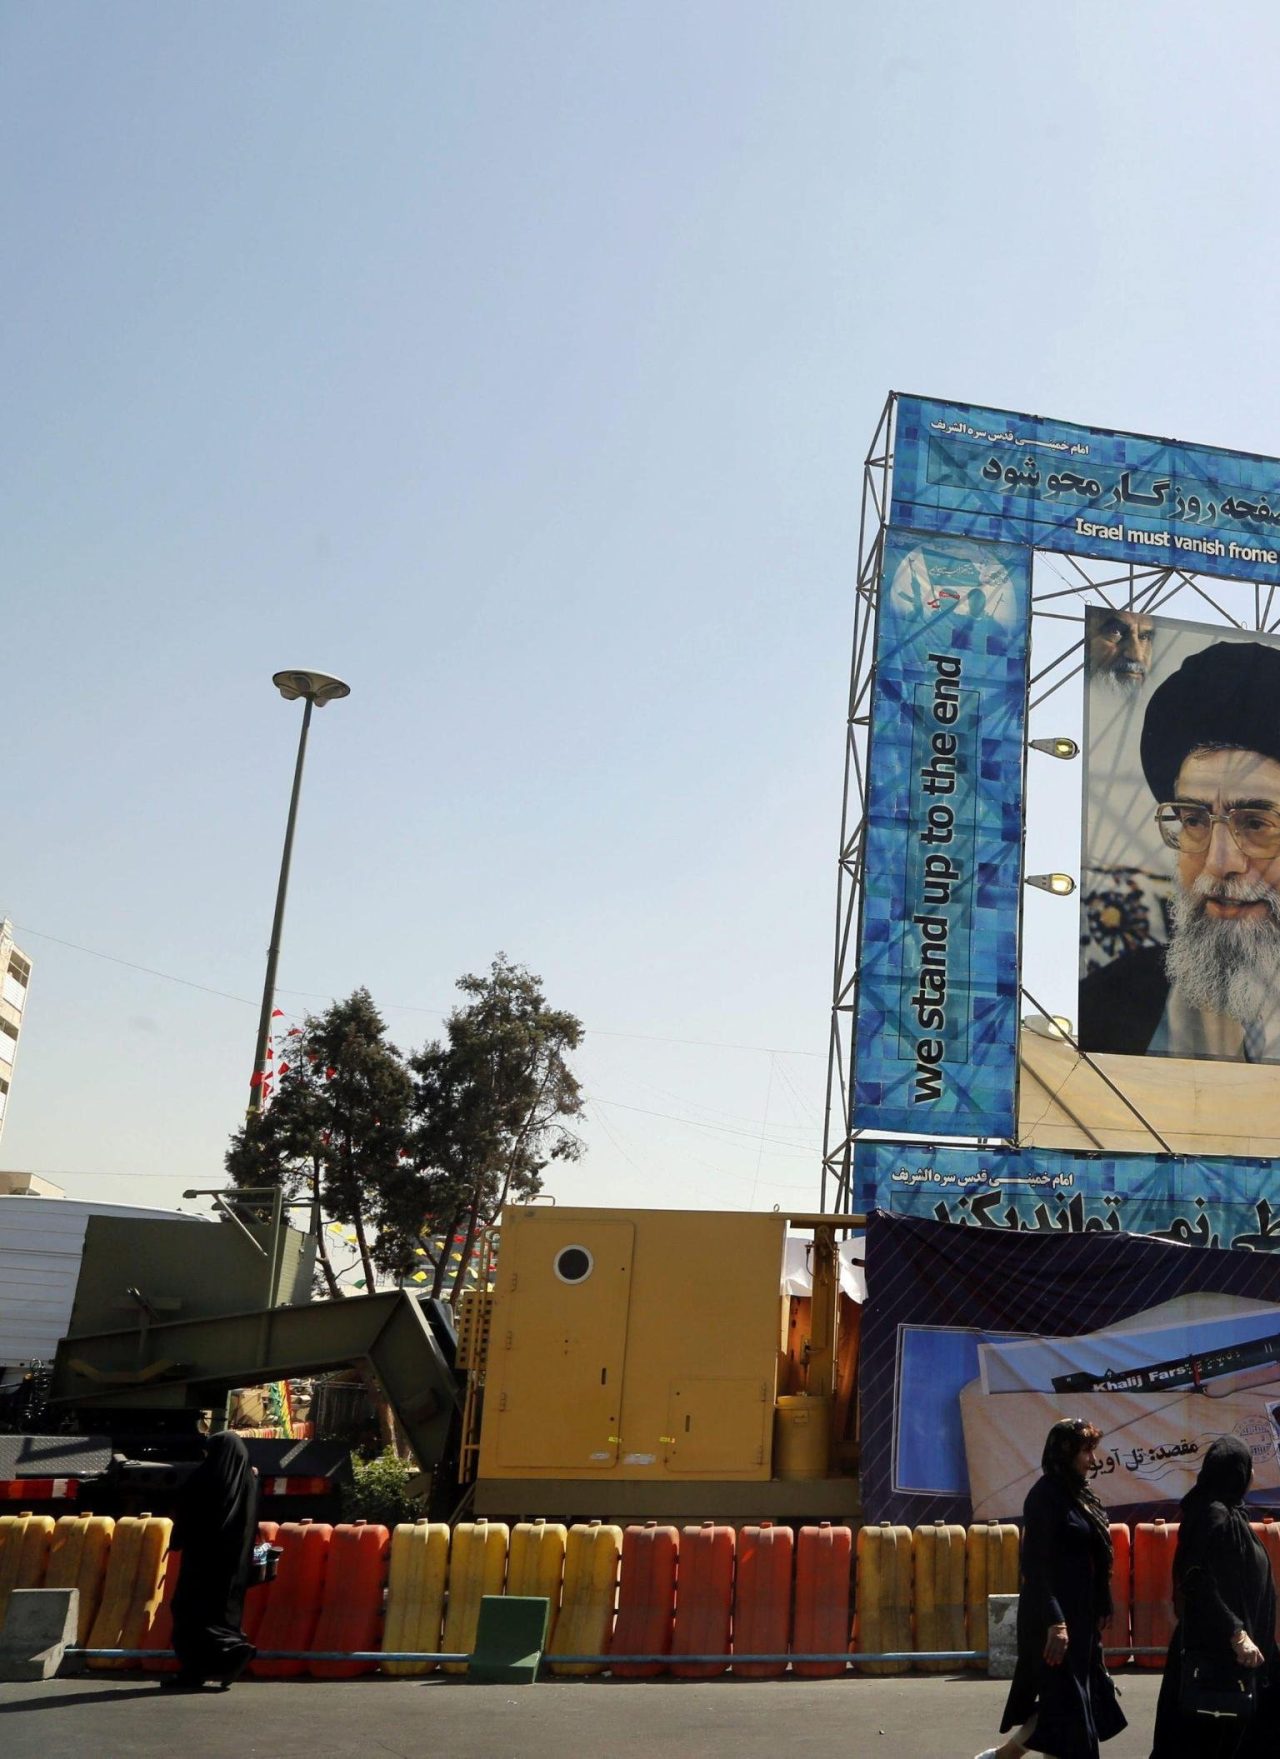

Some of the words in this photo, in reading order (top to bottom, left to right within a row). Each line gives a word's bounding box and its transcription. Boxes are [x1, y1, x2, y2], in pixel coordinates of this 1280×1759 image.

[930, 418, 967, 435] الشریف
[966, 426, 987, 440] سره
[987, 430, 1014, 443] قدس
[1014, 437, 1070, 451] خمینی
[1069, 442, 1090, 455] امام
[981, 456, 1041, 494] شود
[1042, 471, 1102, 501] محو
[1075, 517, 1123, 542] Israel
[1127, 529, 1171, 548] must
[1173, 534, 1225, 557] vanish
[1228, 541, 1278, 564] frome
[928, 653, 962, 726] end
[920, 731, 958, 796] the
[920, 804, 955, 845] to
[923, 853, 960, 905] up
[911, 914, 949, 1031] stand
[914, 1038, 944, 1104] we
[891, 1166, 933, 1187] الشریف
[933, 1170, 956, 1186] سره
[957, 1168, 988, 1187] قدس
[989, 1170, 1051, 1187] خمینی
[1052, 1172, 1074, 1189] امام
[1092, 1374, 1143, 1394] Khalij
[1148, 1364, 1186, 1384] Fars
[1125, 1447, 1143, 1472] تل
[1149, 1438, 1200, 1461] مقصد:
